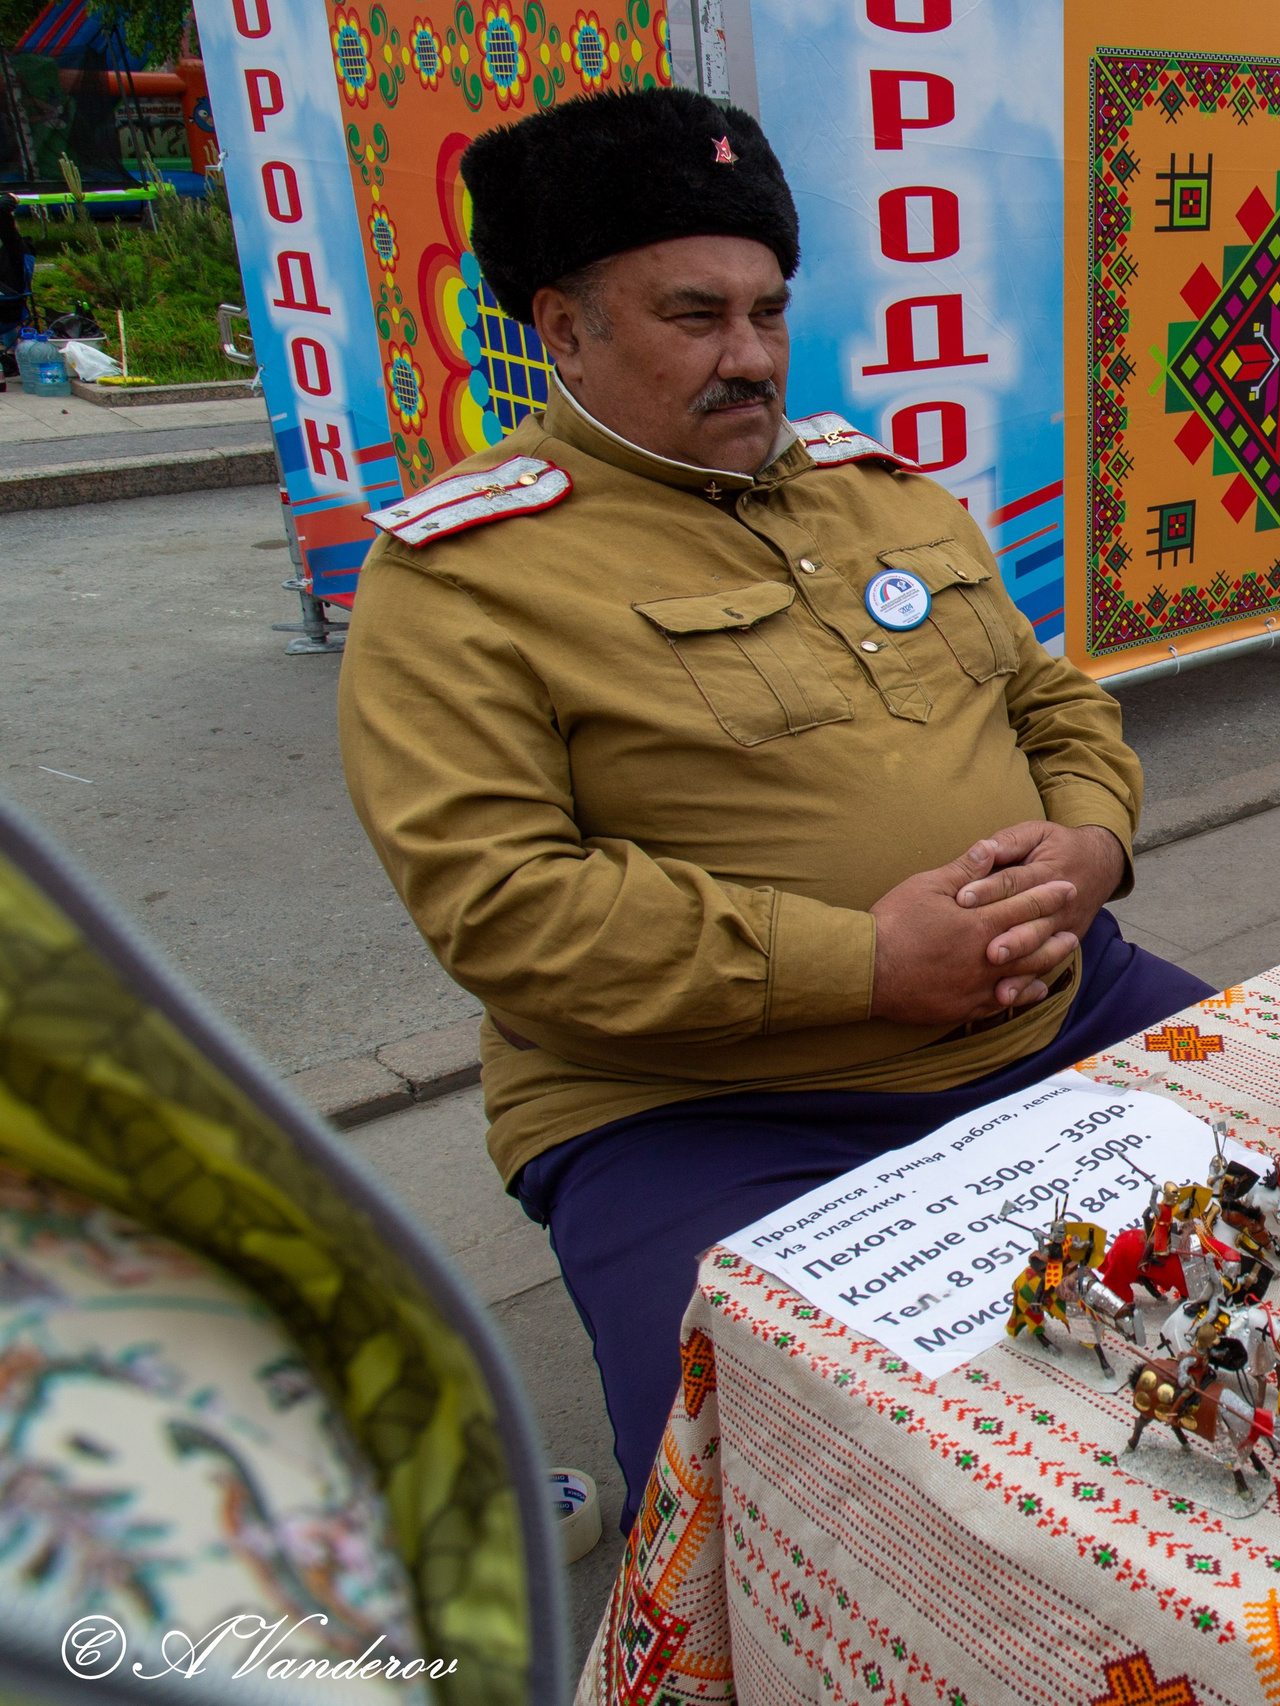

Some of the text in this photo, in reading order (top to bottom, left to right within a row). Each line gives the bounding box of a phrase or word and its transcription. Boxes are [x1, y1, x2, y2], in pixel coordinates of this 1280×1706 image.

[751, 1187, 868, 1248] Продаются
[877, 1151, 947, 1185] Ручная
[950, 1112, 1019, 1151] работа,
[1022, 1085, 1073, 1111] лепка
[774, 1243, 807, 1260] Из
[813, 1192, 906, 1241] пластики
[802, 1218, 917, 1280] Пехота
[925, 1194, 959, 1217] от
[964, 1158, 1045, 1196] 250р.
[1059, 1103, 1135, 1143] 350р.
[838, 1232, 966, 1306] Конные
[967, 1213, 1001, 1233] от
[873, 1292, 951, 1326] Тел.
[946, 1270, 974, 1288] 8
[971, 1239, 1032, 1274] 951
[1079, 1186, 1120, 1214] 84
